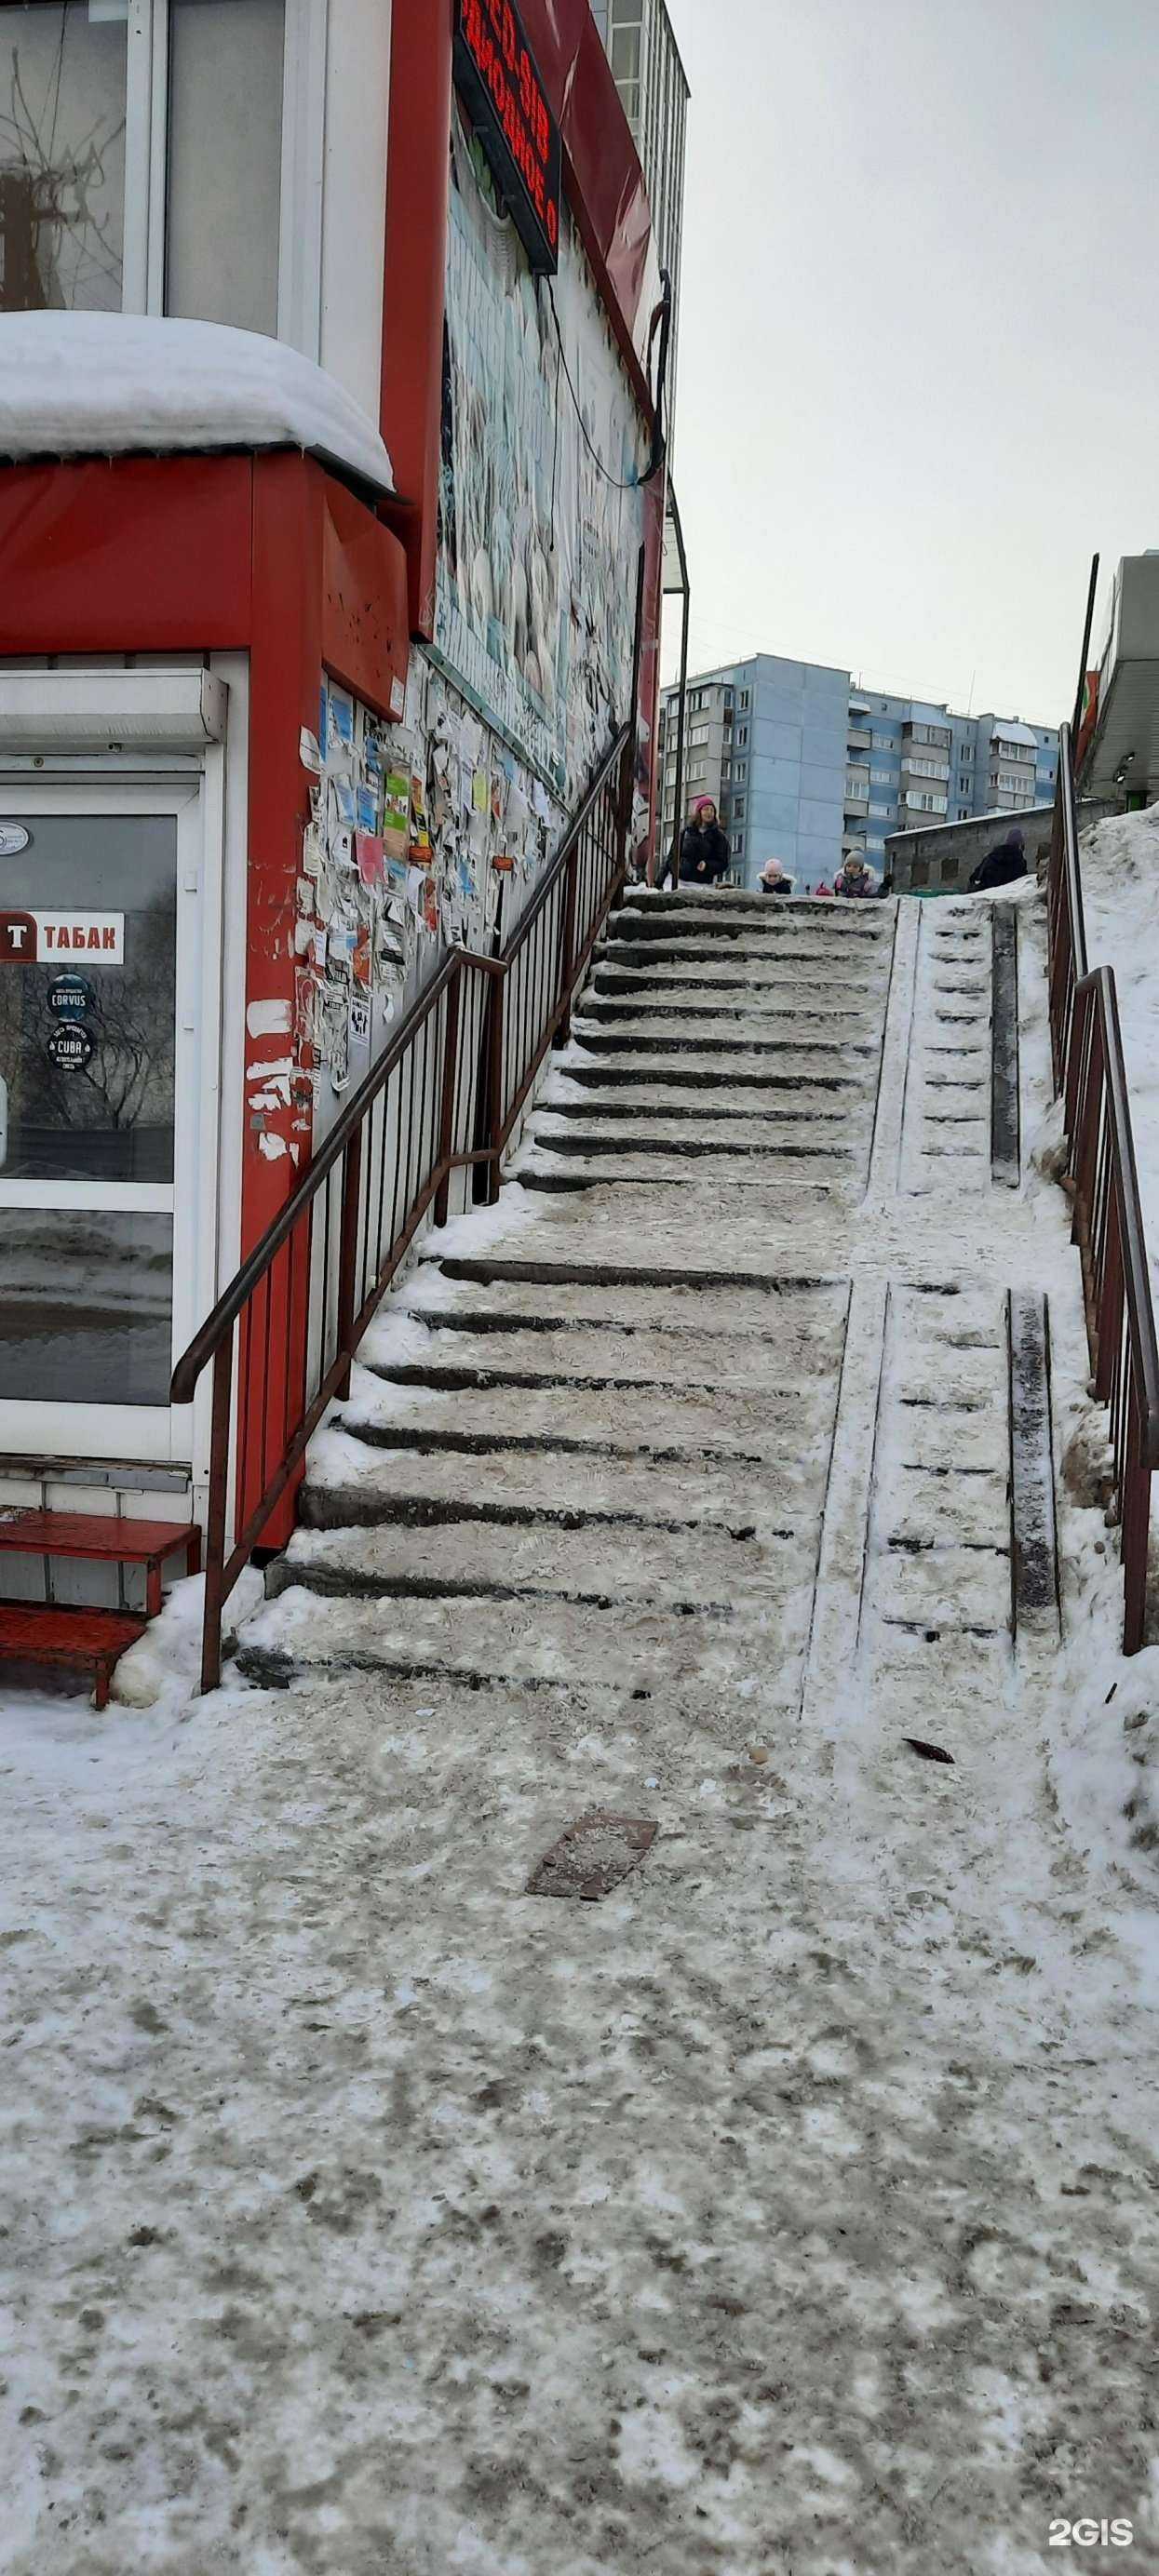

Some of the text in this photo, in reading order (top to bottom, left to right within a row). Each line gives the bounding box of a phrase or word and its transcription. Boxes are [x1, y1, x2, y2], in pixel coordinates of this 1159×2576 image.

[44, 926, 115, 949] ТАБАК
[52, 995, 86, 1006] CORVUS
[58, 1040, 82, 1053] CUBA
